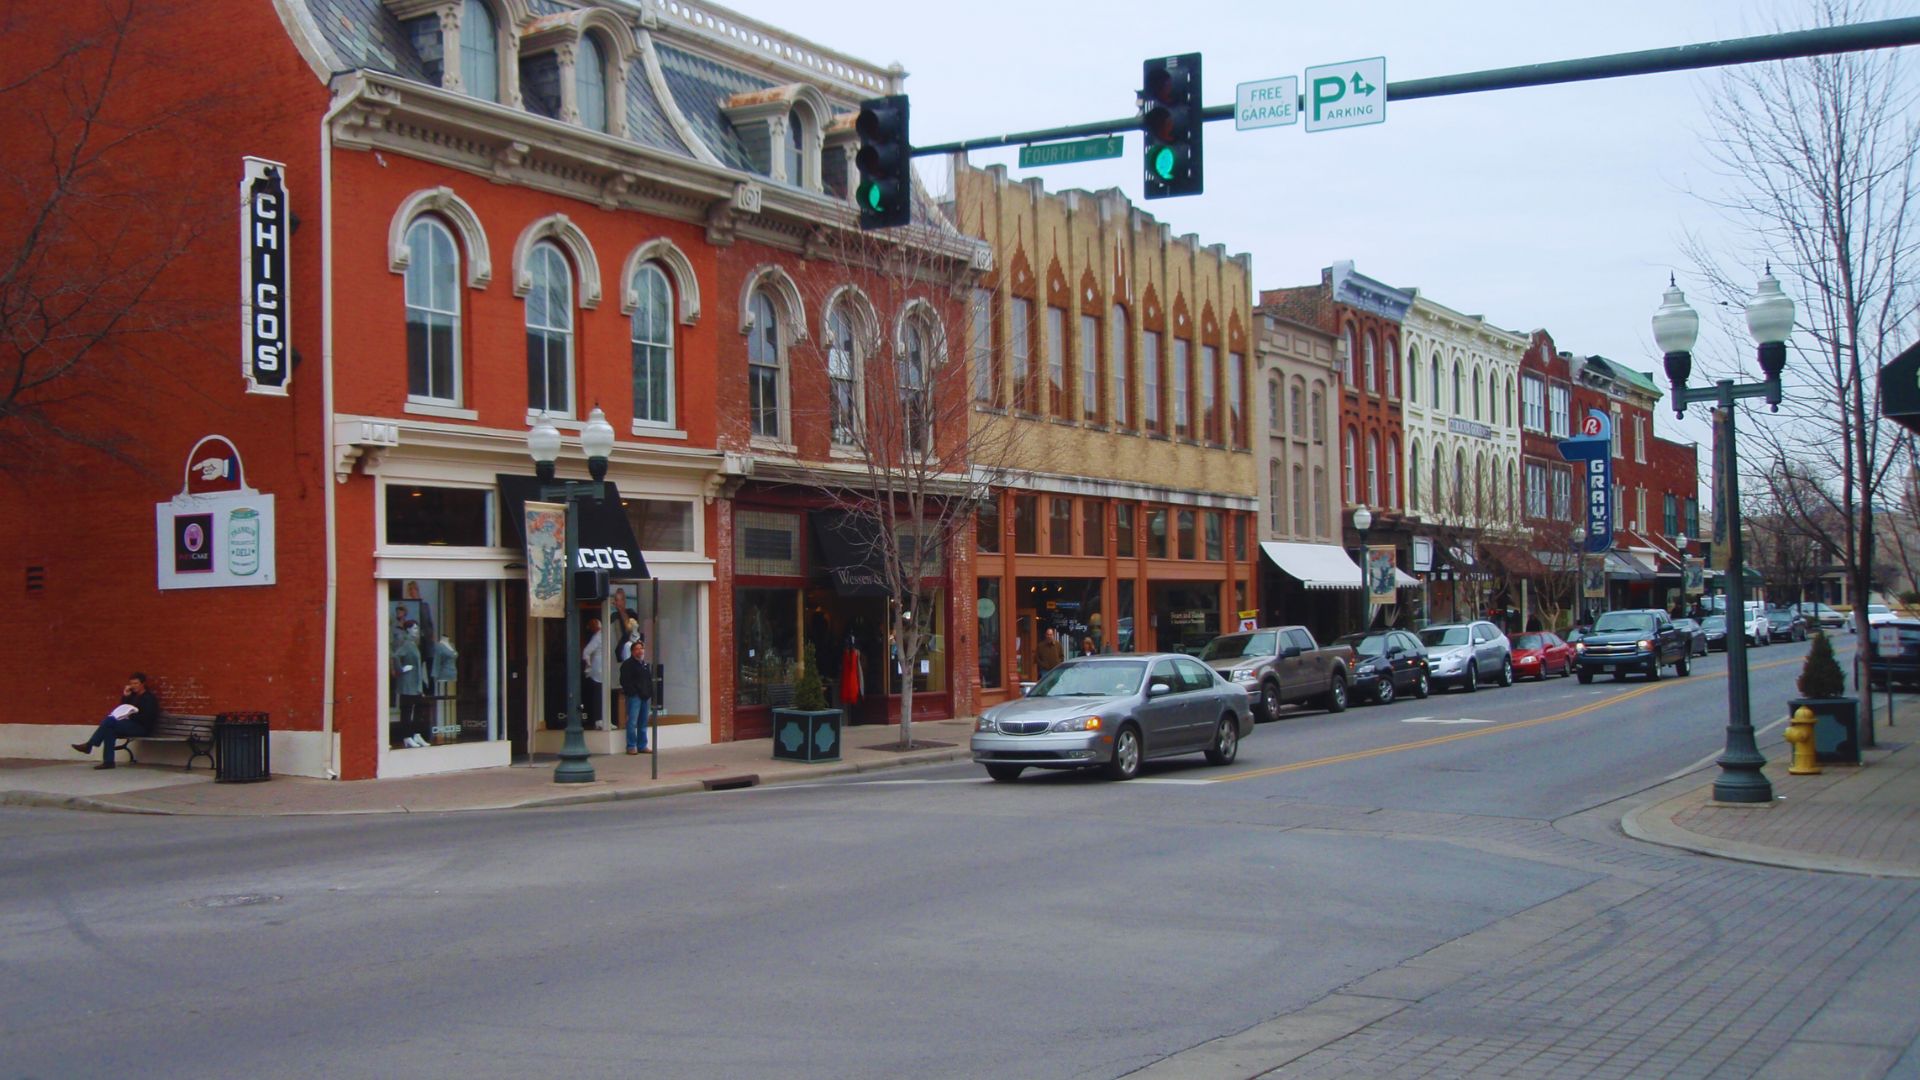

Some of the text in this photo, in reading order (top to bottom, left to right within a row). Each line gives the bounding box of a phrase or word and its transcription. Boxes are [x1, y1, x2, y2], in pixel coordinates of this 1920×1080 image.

[1251, 86, 1282, 102] FREE
[1241, 103, 1292, 122] GARAGE
[1024, 143, 1076, 164] FOURTH
[1106, 139, 1115, 154] S
[256, 192, 283, 371] CHICO'S
[1590, 459, 1607, 535] GRAY'S
